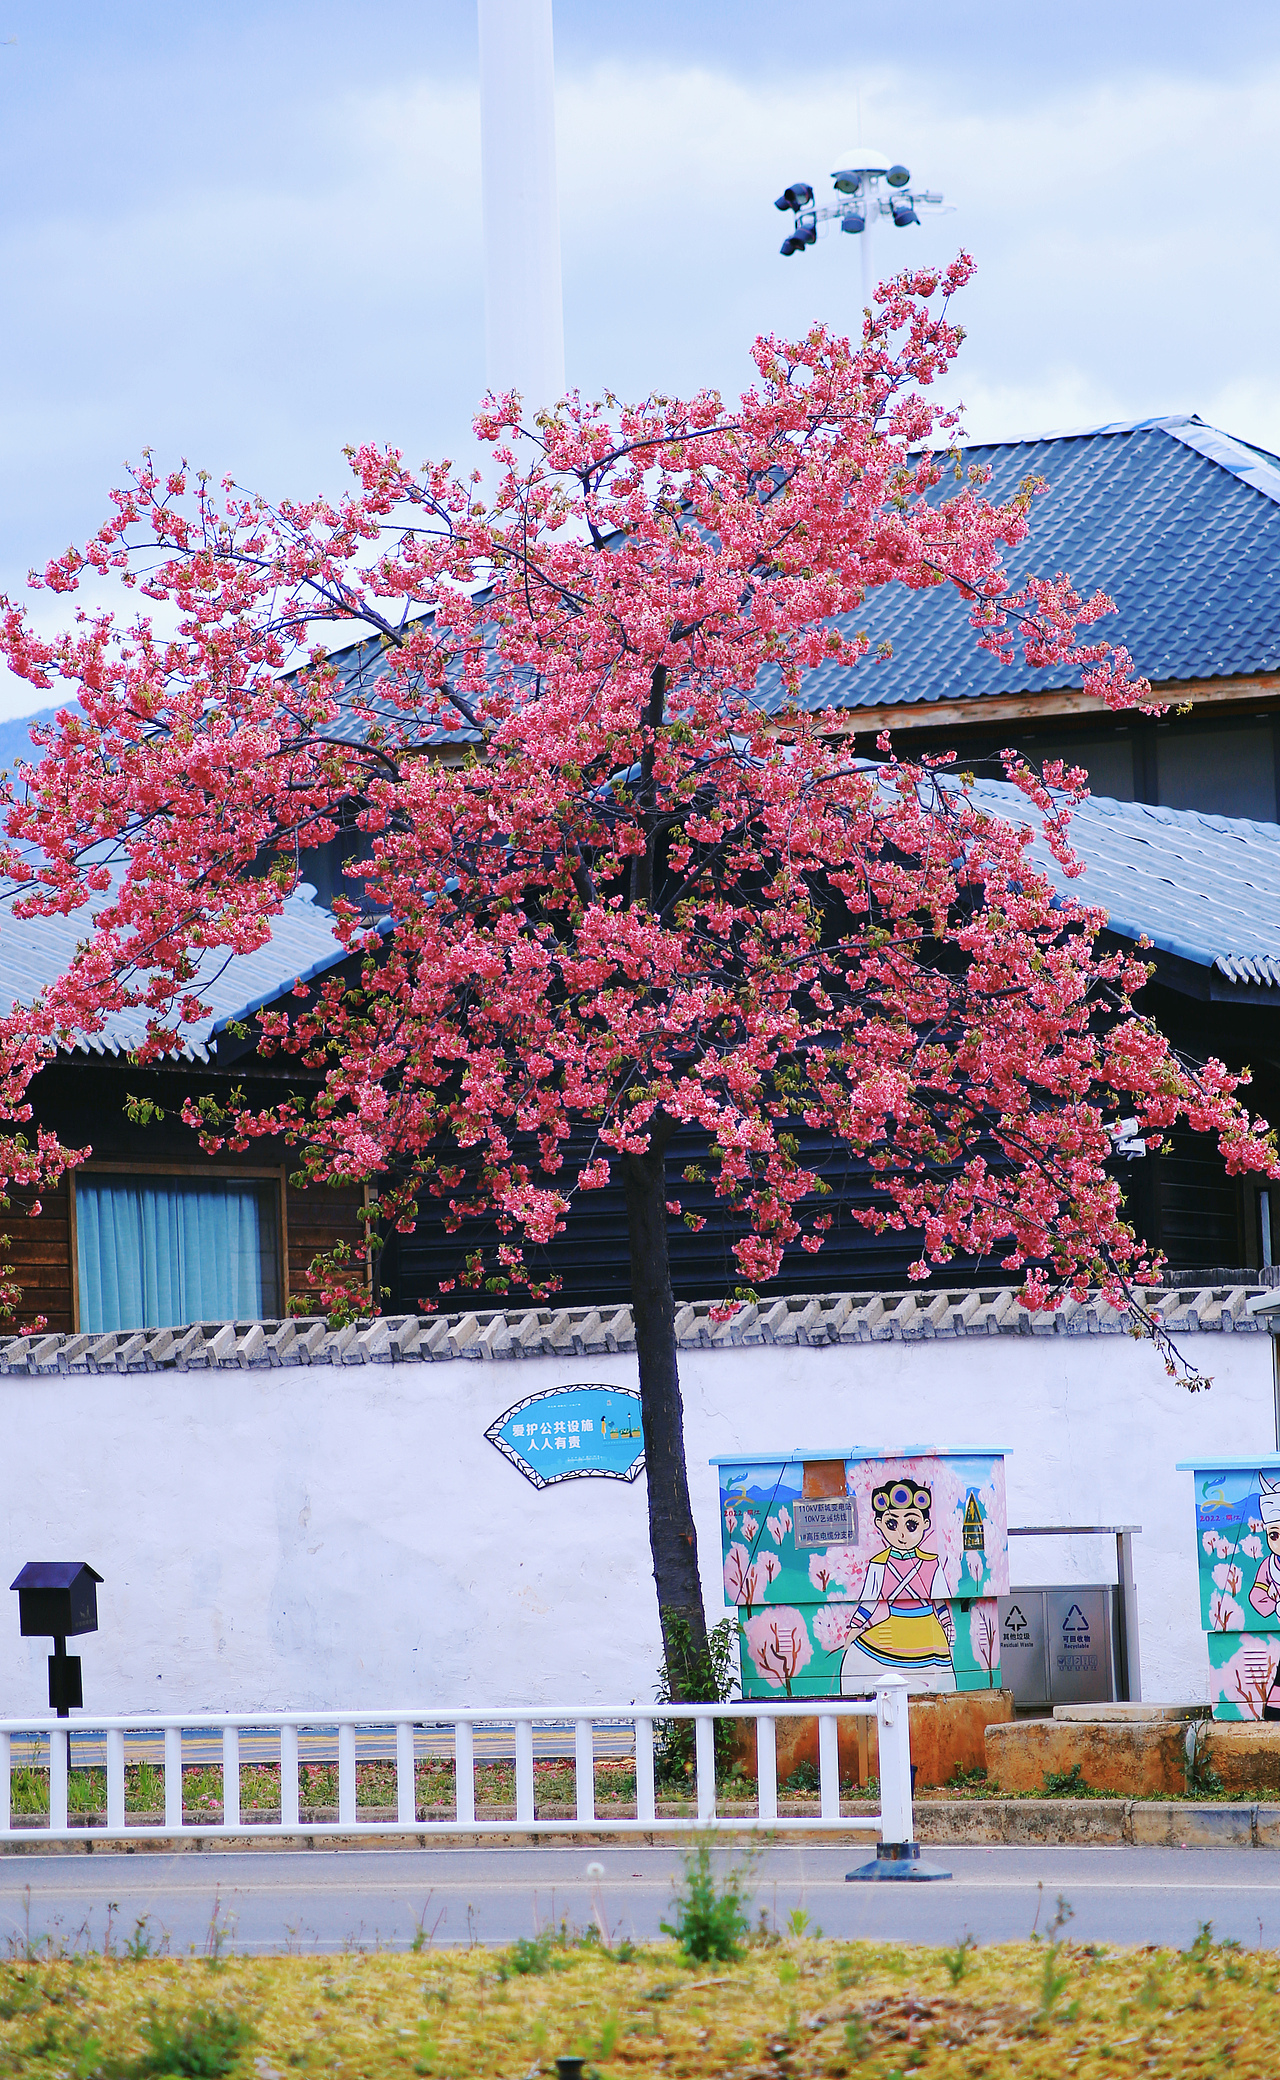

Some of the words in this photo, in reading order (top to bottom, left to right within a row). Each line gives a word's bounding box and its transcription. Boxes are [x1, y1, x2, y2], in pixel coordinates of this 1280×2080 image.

[512, 1418, 594, 1437] 爱护公共设施
[527, 1435, 581, 1451] 人人有责
[1003, 1632, 1031, 1641] 其他垃圾
[1063, 1634, 1091, 1643] 可回收物
